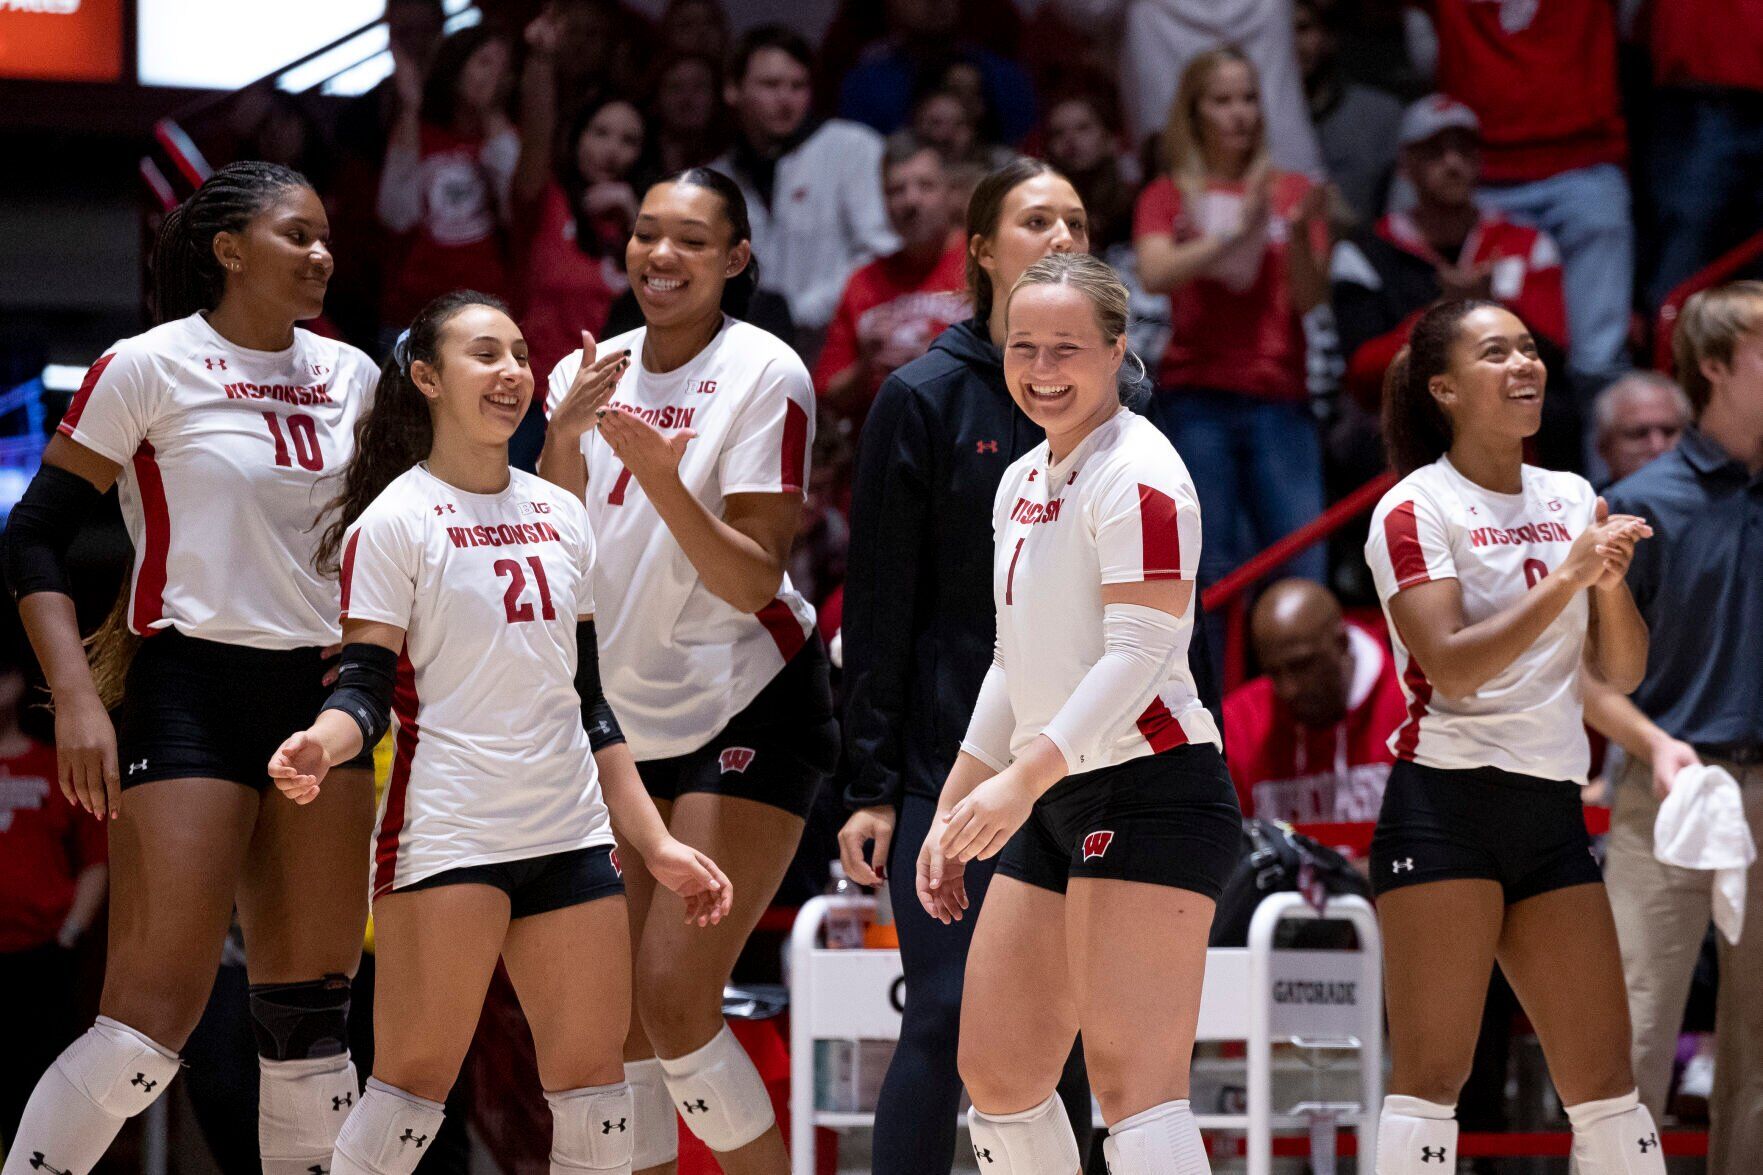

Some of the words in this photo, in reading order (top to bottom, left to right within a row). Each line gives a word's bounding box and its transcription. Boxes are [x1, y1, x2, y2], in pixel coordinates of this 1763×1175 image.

[261, 411, 324, 472] 10
[446, 521, 561, 548] WISCONSIN
[1468, 521, 1573, 548] WISCONSIN
[493, 555, 556, 624] 21
[718, 746, 756, 774] W
[1081, 830, 1115, 863] W
[1272, 980, 1356, 1006] GATORADE
